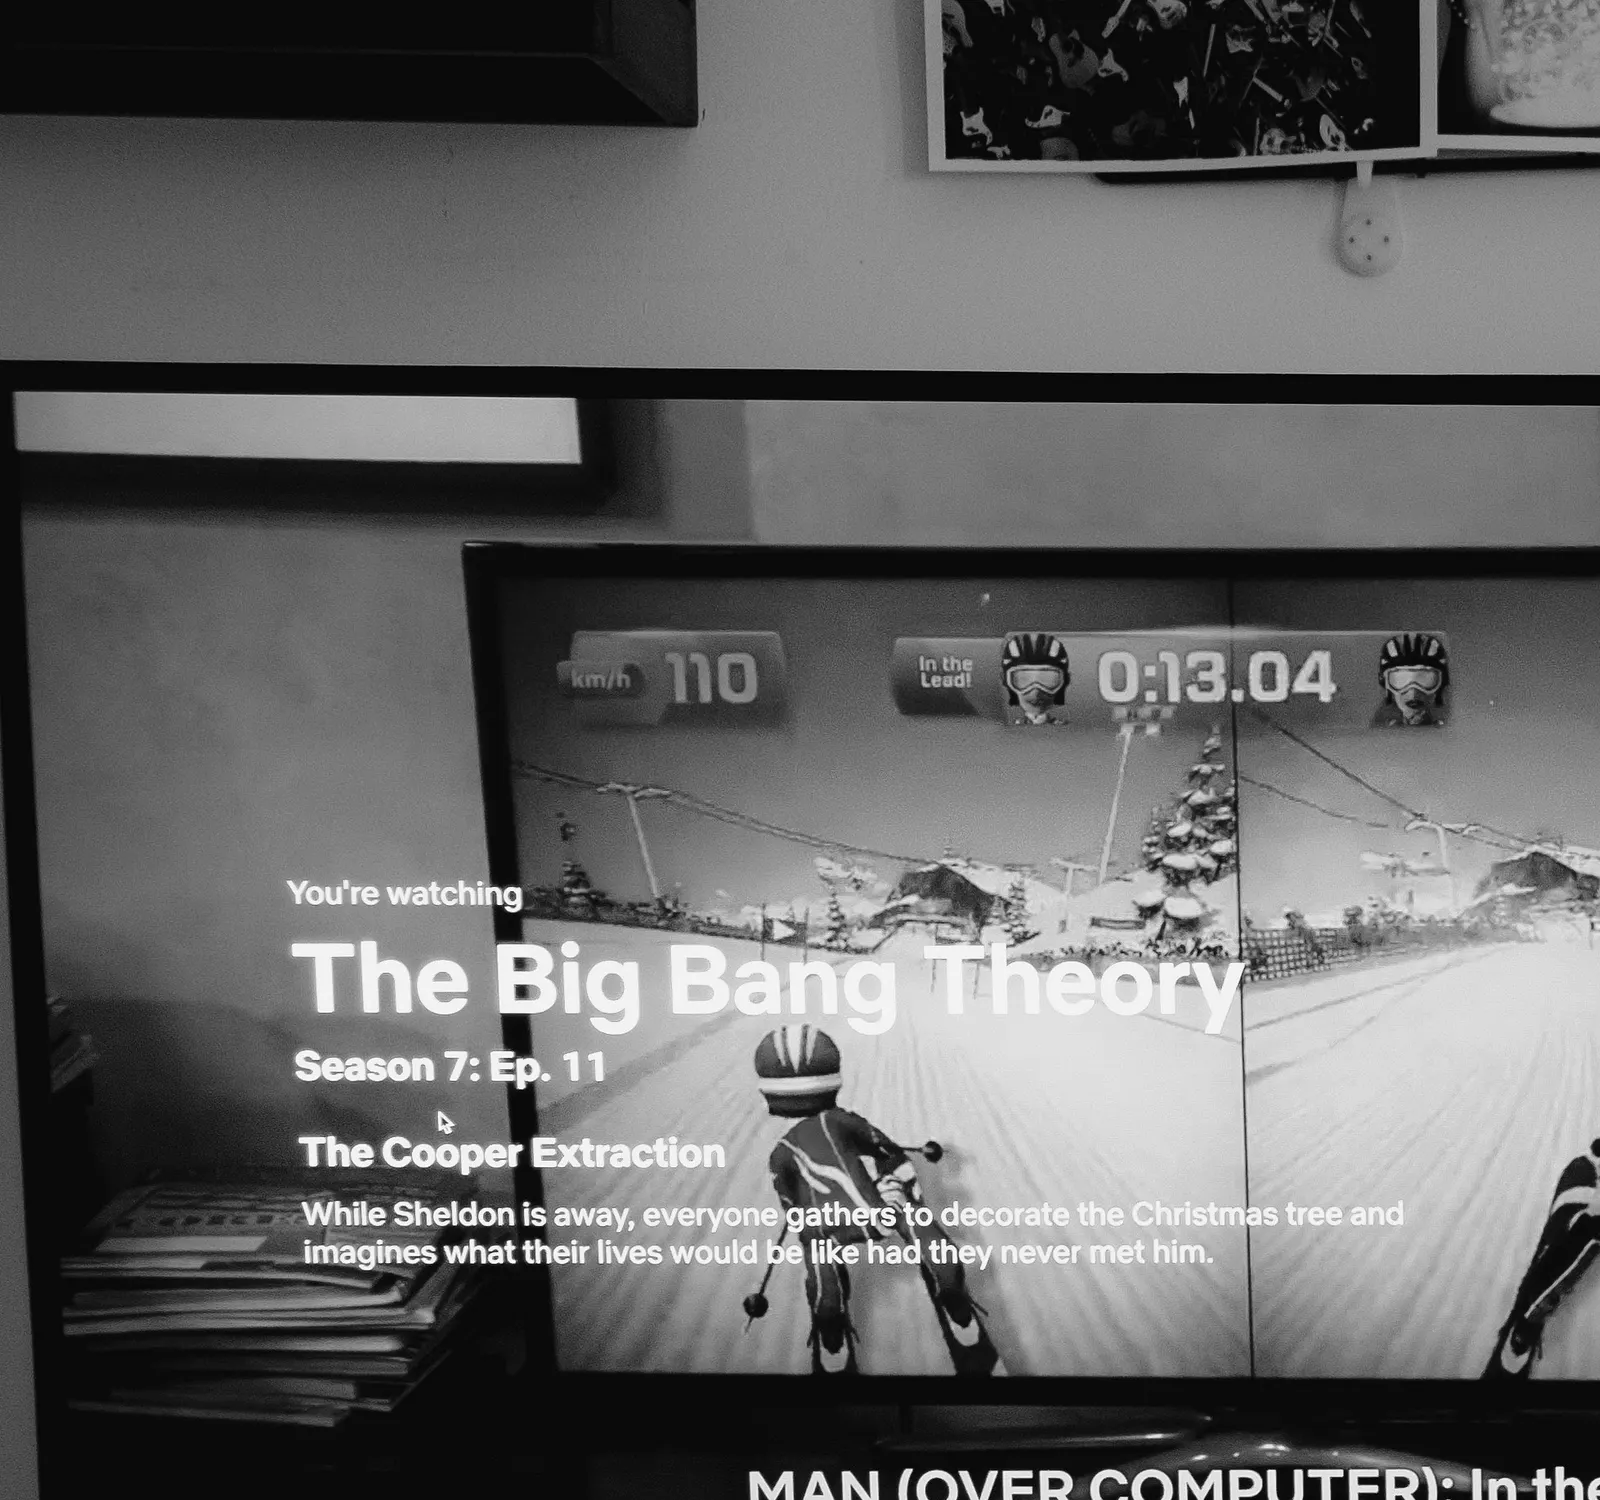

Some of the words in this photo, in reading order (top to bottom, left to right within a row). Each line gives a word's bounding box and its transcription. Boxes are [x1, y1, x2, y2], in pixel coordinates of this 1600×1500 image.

[571, 668, 631, 690] km/h
[666, 653, 757, 703] 110
[919, 656, 941, 671] In
[950, 656, 972, 671] the
[1098, 650, 1336, 702] 0:13.04
[920, 672, 972, 688] Lead!
[288, 881, 378, 904] You're
[388, 881, 520, 911] watching
[293, 942, 467, 1014] The
[498, 942, 639, 1034] Big
[671, 946, 896, 1035] Bang
[924, 943, 1244, 1033] Theory
[296, 1051, 433, 1080] Season
[445, 1052, 479, 1080] 7:
[491, 1052, 550, 1088] Ep.
[564, 1052, 603, 1080] 11
[300, 1137, 372, 1166] The
[384, 1138, 521, 1174] Cooper
[534, 1137, 724, 1167] Extraction
[303, 1202, 384, 1225] While
[395, 1202, 513, 1225] Sheldon
[524, 1203, 545, 1225] is
[555, 1209, 634, 1231] away,
[644, 1208, 777, 1232] everyone
[787, 1202, 895, 1232] gathers
[904, 1204, 932, 1225] to
[942, 1202, 1069, 1226] decorate
[1077, 1202, 1124, 1225] the
[1133, 1201, 1278, 1225] Christmas
[1286, 1203, 1342, 1225] tree
[1351, 1201, 1403, 1225] and
[306, 1241, 435, 1269] imagines
[445, 1240, 515, 1263] what
[524, 1240, 588, 1263] their
[599, 1240, 662, 1263] lives
[671, 1240, 757, 1263] would
[768, 1240, 802, 1263] be
[813, 1240, 858, 1263] like
[869, 1240, 919, 1263] had
[930, 1240, 992, 1269] they
[1002, 1246, 1081, 1263] never
[1090, 1240, 1144, 1263] met
[1154, 1239, 1212, 1262] him.
